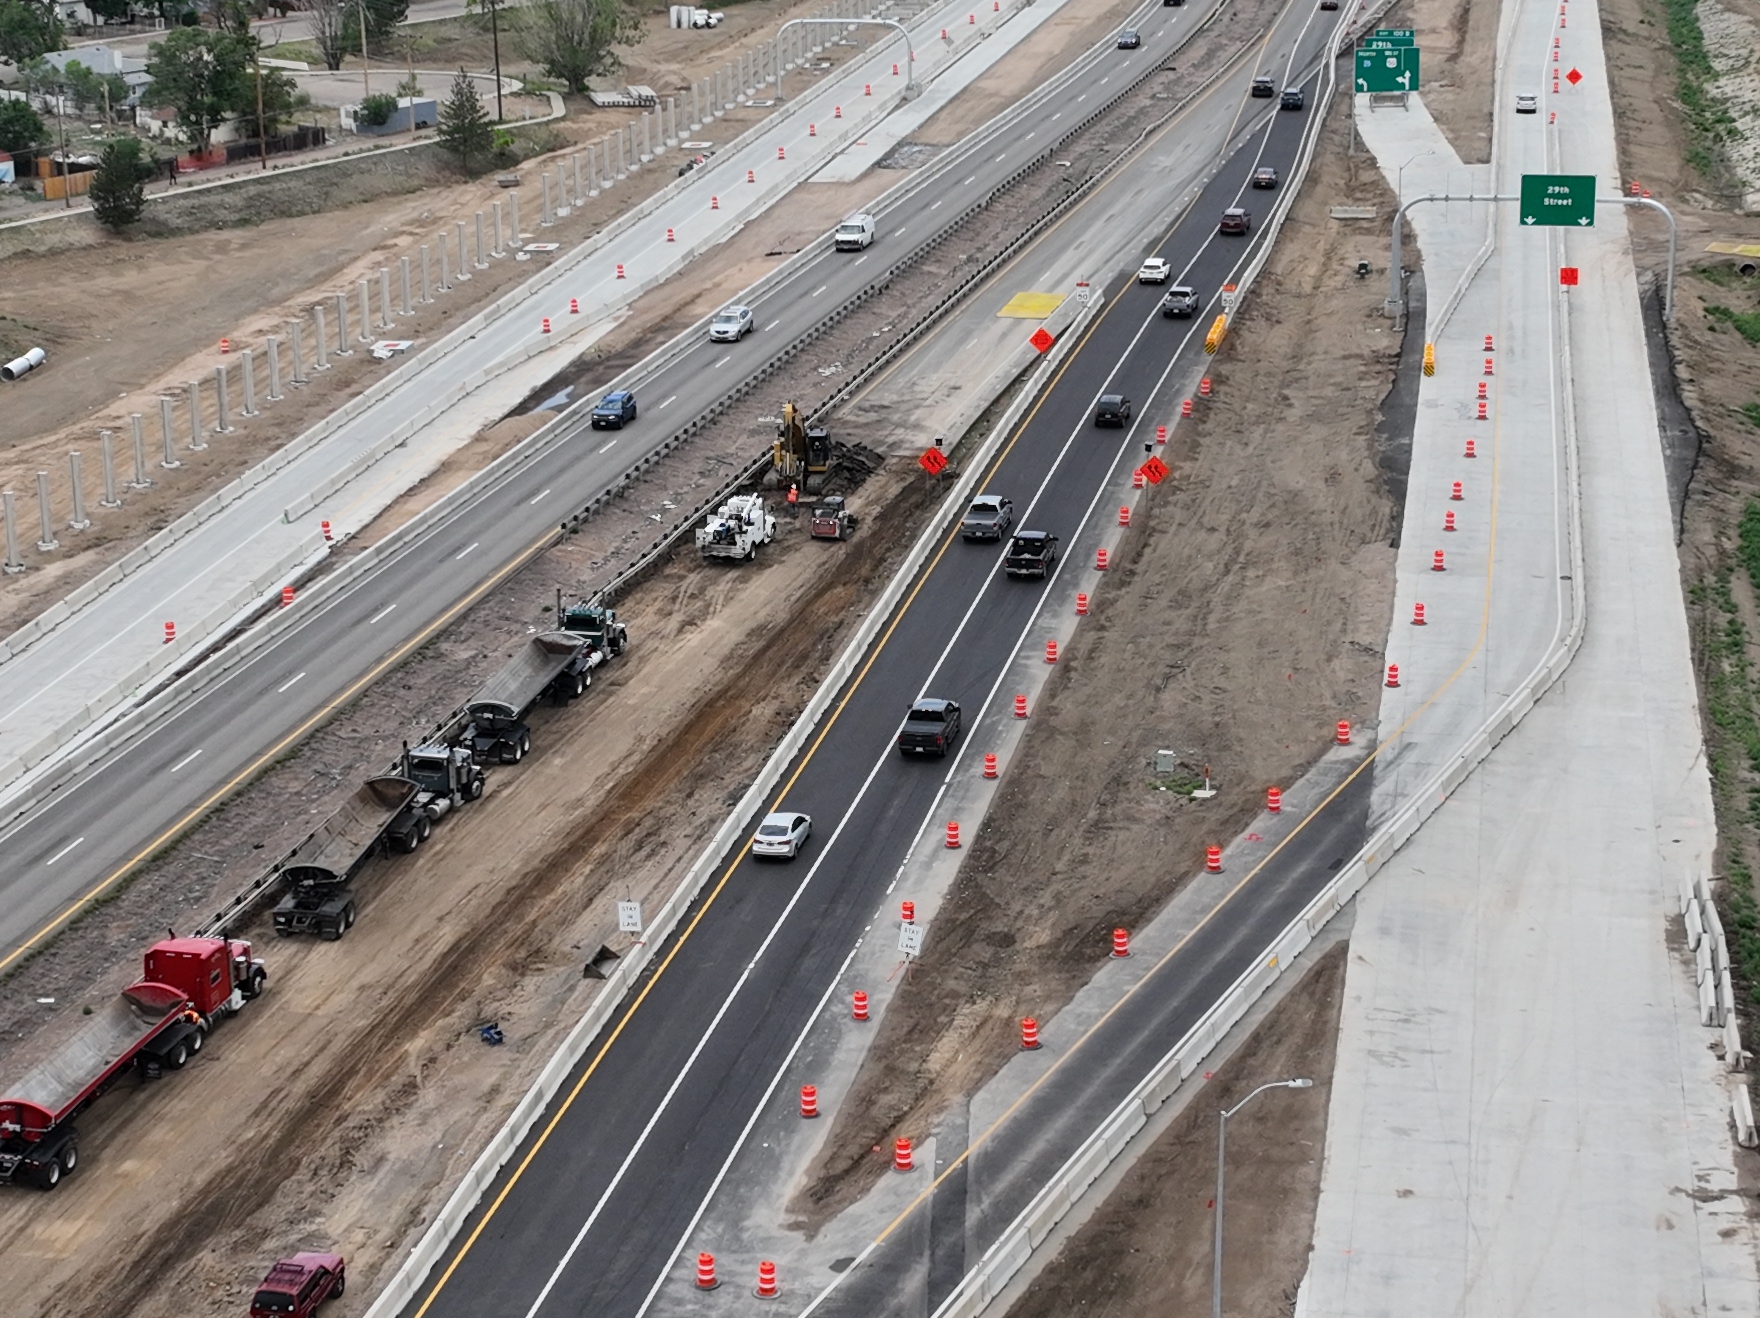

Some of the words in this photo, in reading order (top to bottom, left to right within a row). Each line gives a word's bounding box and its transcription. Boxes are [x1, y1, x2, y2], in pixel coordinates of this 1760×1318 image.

[1546, 185, 1570, 195] 29th
[1543, 197, 1573, 206] Street
[904, 927, 920, 935] STAY
